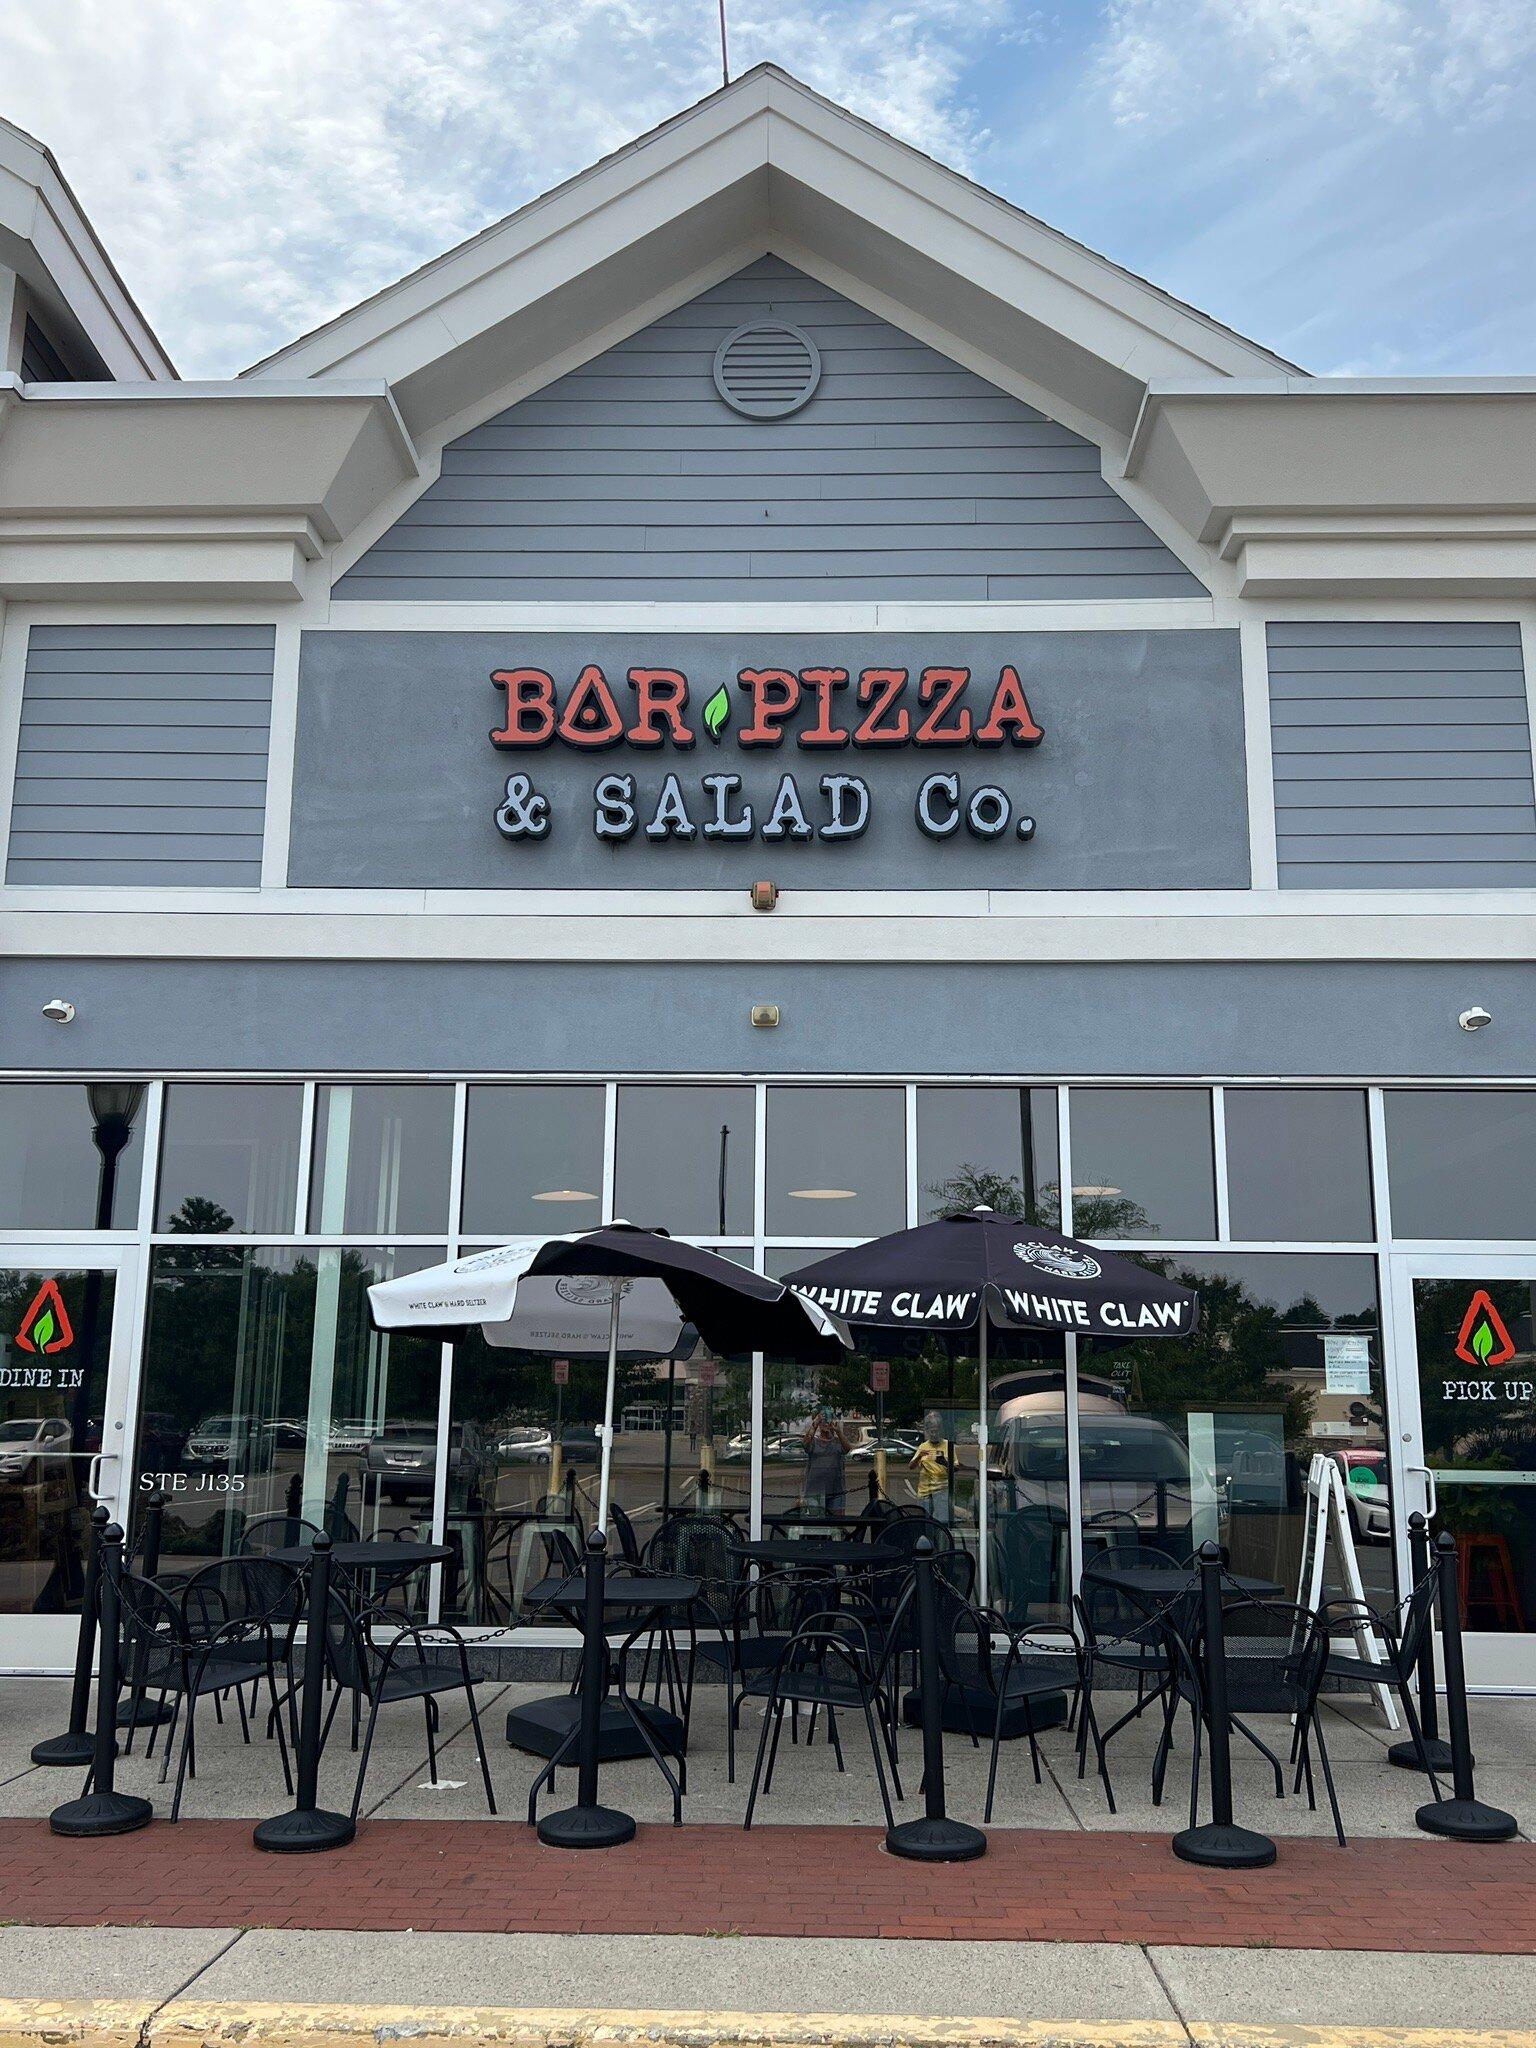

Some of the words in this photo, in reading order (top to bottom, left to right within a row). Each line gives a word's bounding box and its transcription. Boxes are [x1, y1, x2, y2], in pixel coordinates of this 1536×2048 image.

[490, 664, 697, 750] BAR
[737, 664, 1045, 750] PIZZA
[494, 771, 551, 841] &
[593, 771, 872, 843] SALAD
[915, 771, 1037, 842] Co.
[428, 1301, 443, 1309] CLAW
[466, 1298, 487, 1306] SELTZER
[1005, 1289, 1090, 1326] WHITE
[0, 1368, 52, 1387] DINE
[57, 1368, 84, 1387] IN
[1442, 1381, 1497, 1400] PICK
[1503, 1381, 1533, 1400] UP
[139, 1473, 188, 1491] STE
